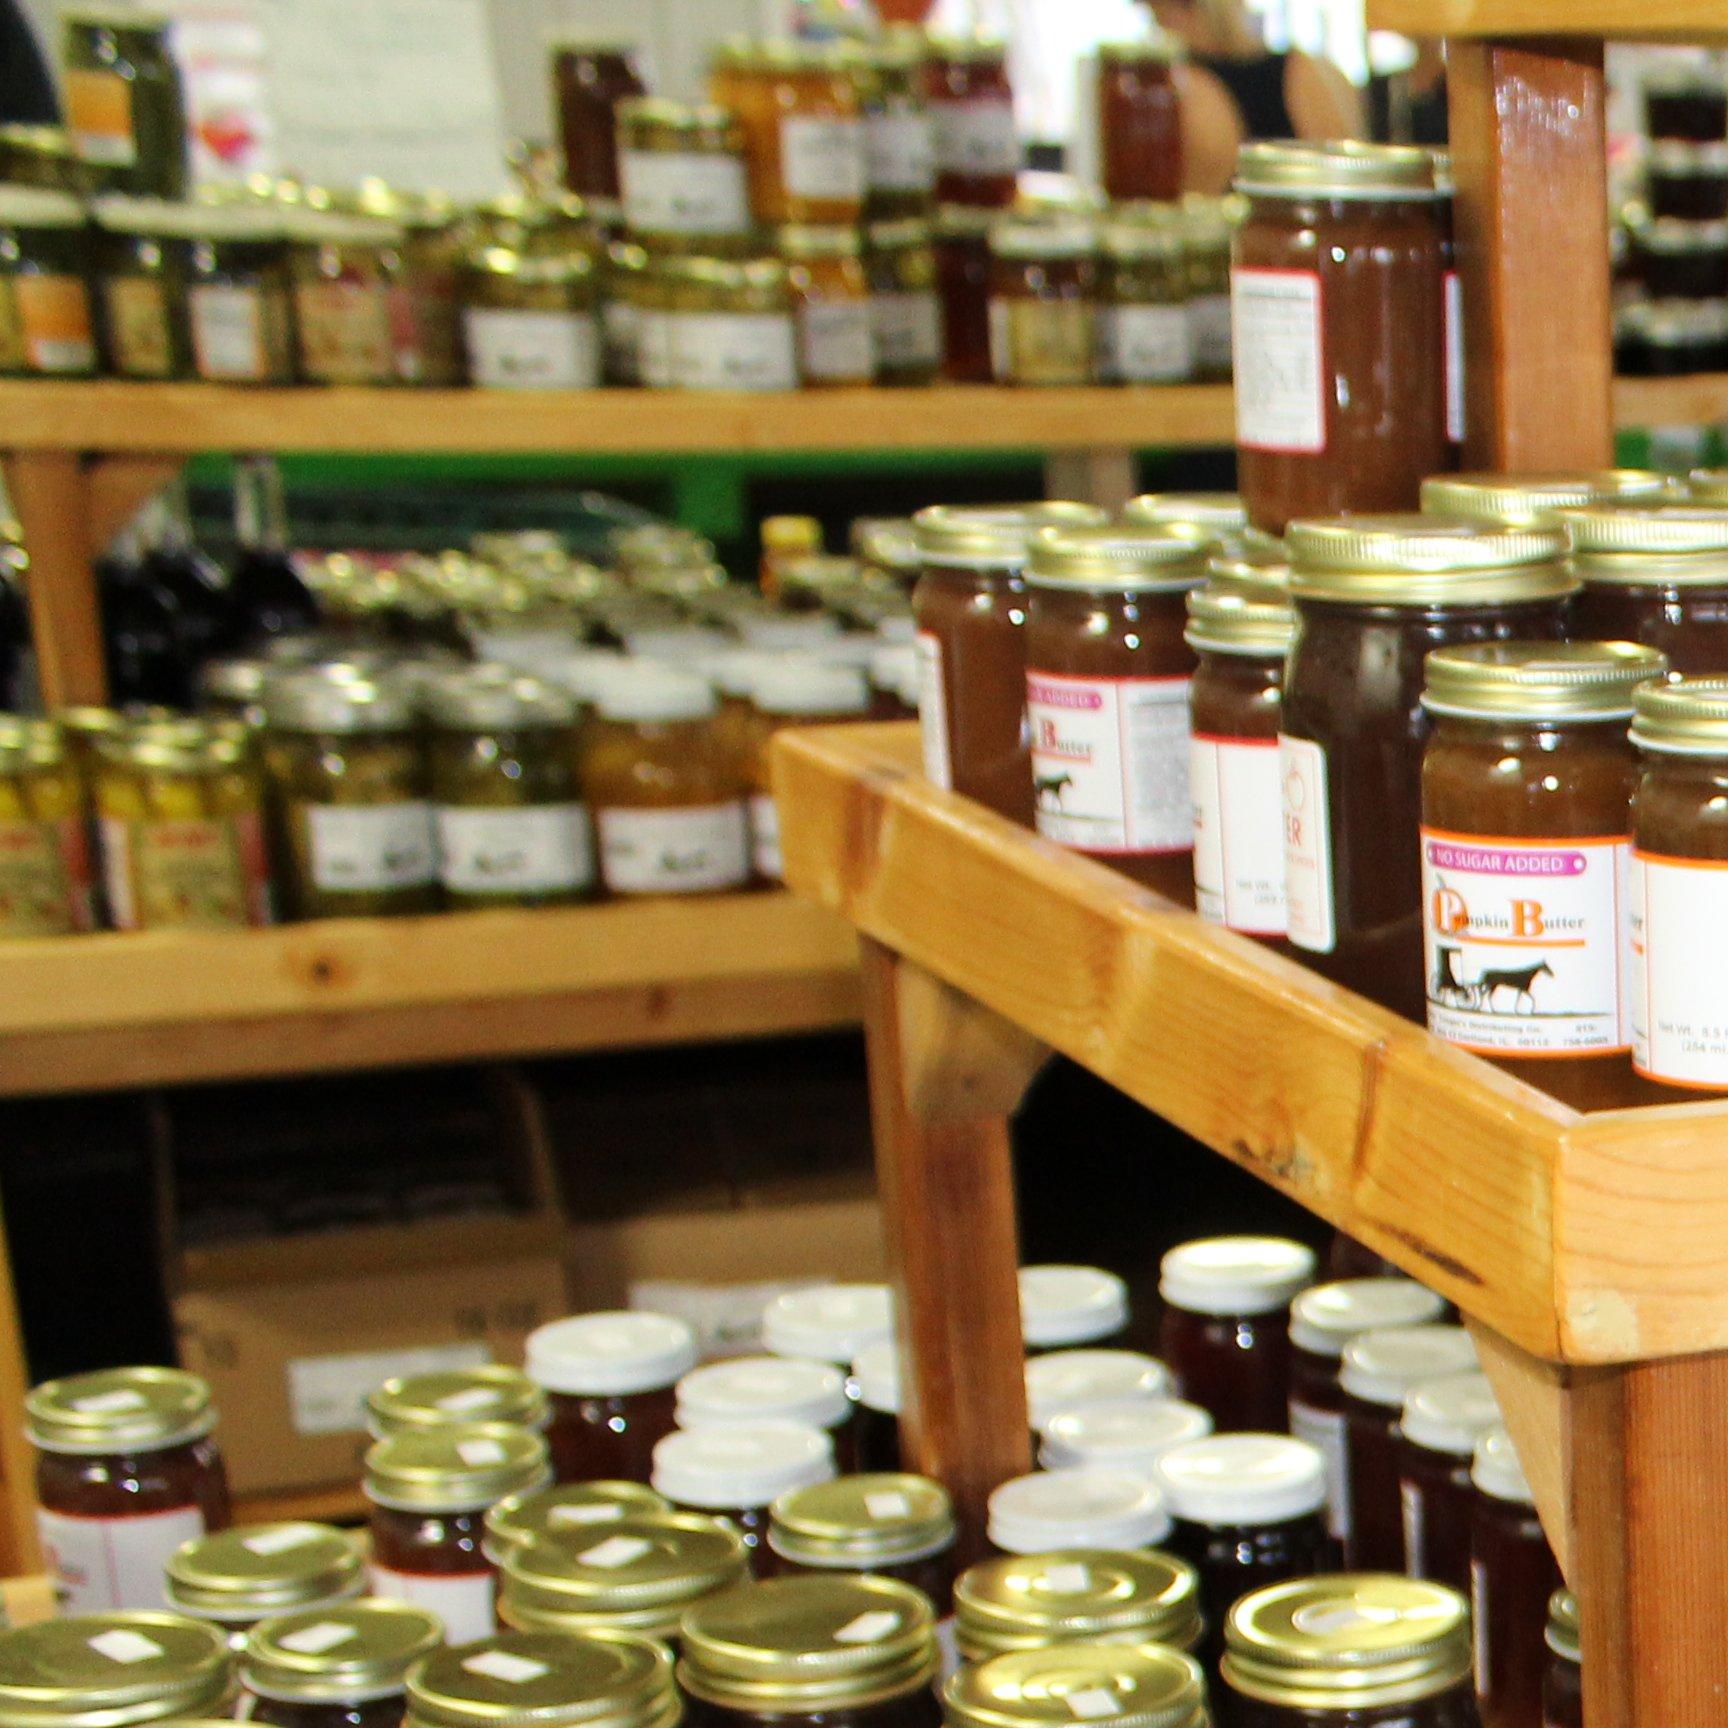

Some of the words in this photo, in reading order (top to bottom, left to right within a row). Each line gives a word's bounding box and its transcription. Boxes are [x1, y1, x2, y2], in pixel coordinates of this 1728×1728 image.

[1436, 849, 1454, 867] NO
[1456, 851, 1501, 871] SUGAR
[1504, 854, 1565, 873] ADDED
[1509, 899, 1585, 937] Butter
